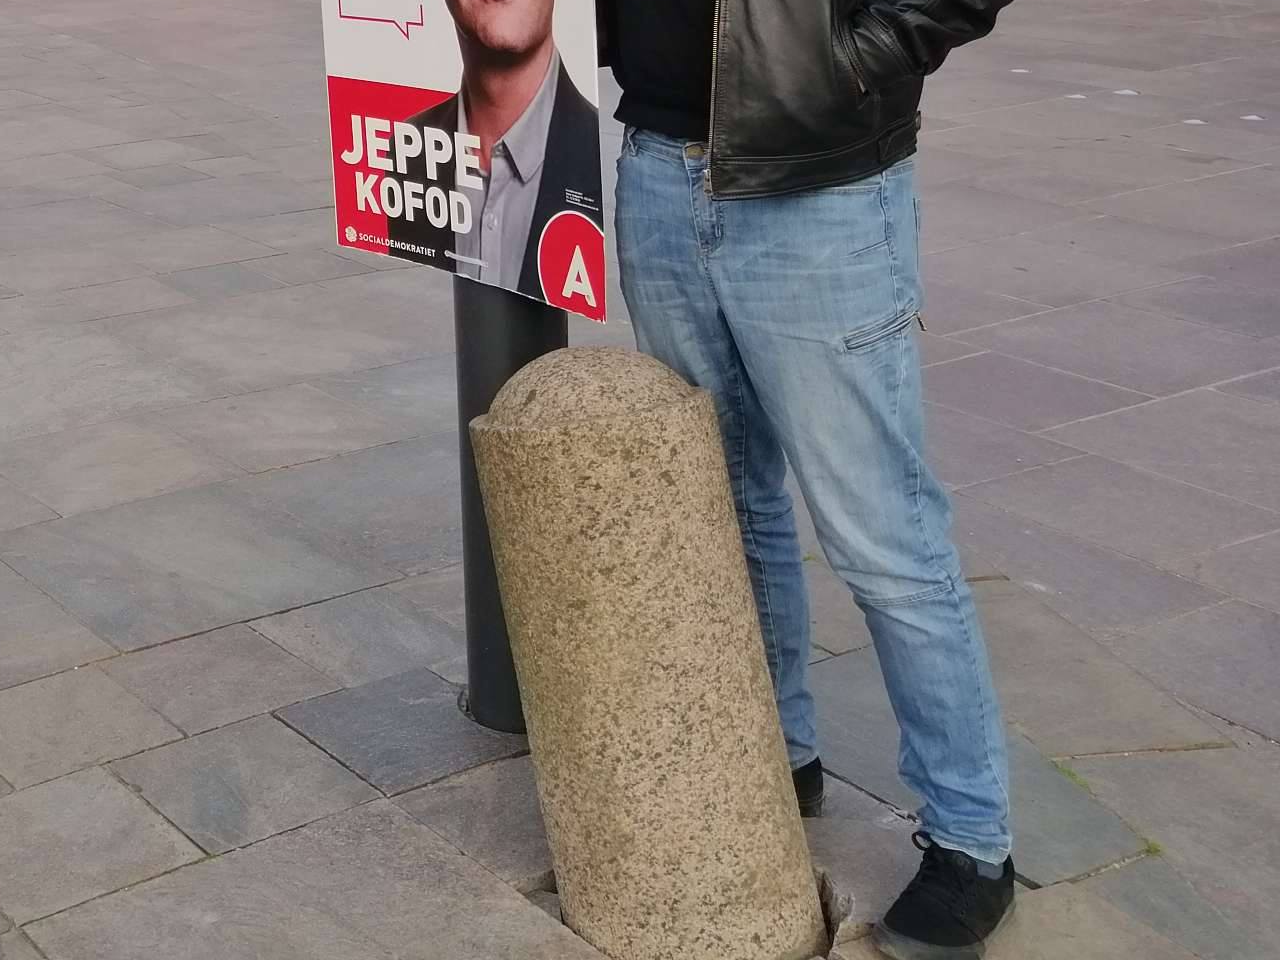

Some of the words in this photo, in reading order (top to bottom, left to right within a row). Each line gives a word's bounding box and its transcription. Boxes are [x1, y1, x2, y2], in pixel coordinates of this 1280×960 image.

[340, 114, 484, 190] JEPPE
[355, 171, 472, 234] KOFOD
[358, 233, 436, 258] SOCIALDEMOKRATIET
[562, 245, 597, 308] A
